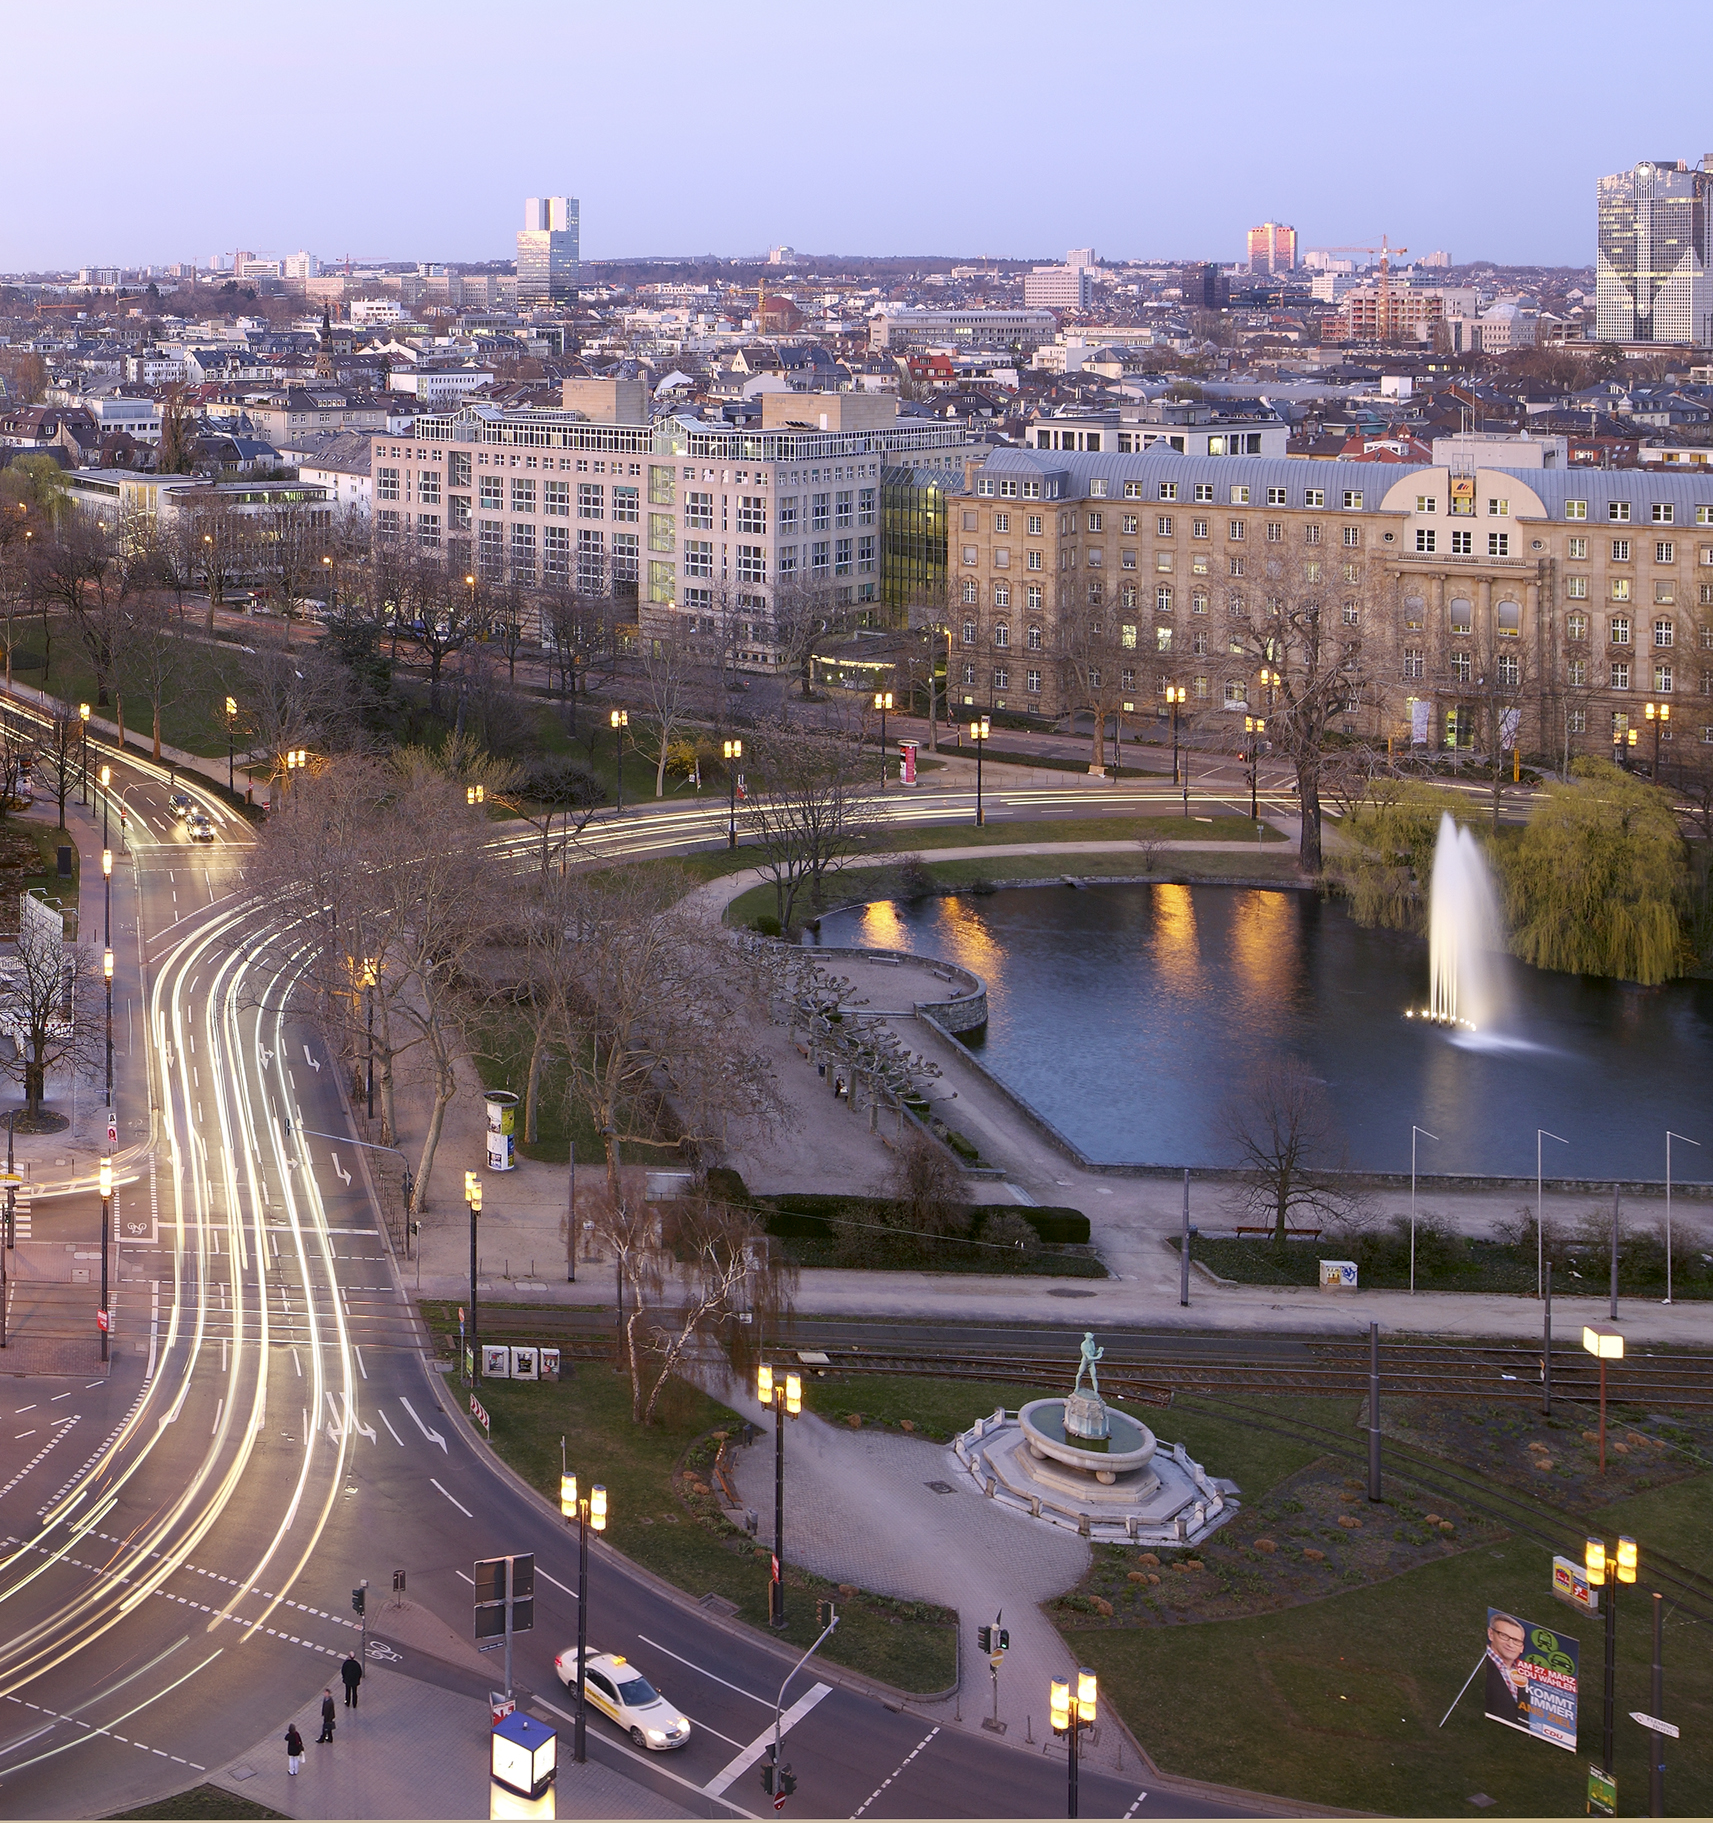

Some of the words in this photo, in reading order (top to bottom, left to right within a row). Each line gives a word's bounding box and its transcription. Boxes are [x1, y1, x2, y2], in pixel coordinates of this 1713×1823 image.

[1517, 1660, 1533, 1671] AM
[1534, 1666, 1546, 1676] 27.
[1547, 1669, 1576, 1685] MÄRZ
[1517, 1668, 1537, 1680] CDU
[1538, 1674, 1577, 1692] WÄHLEN
[1525, 1685, 1575, 1710] KOMMT
[1530, 1696, 1575, 1721] IMMER
[1518, 1701, 1545, 1718] ANS
[1546, 1712, 1574, 1730] ZIEL
[1543, 1728, 1563, 1740] CDU
